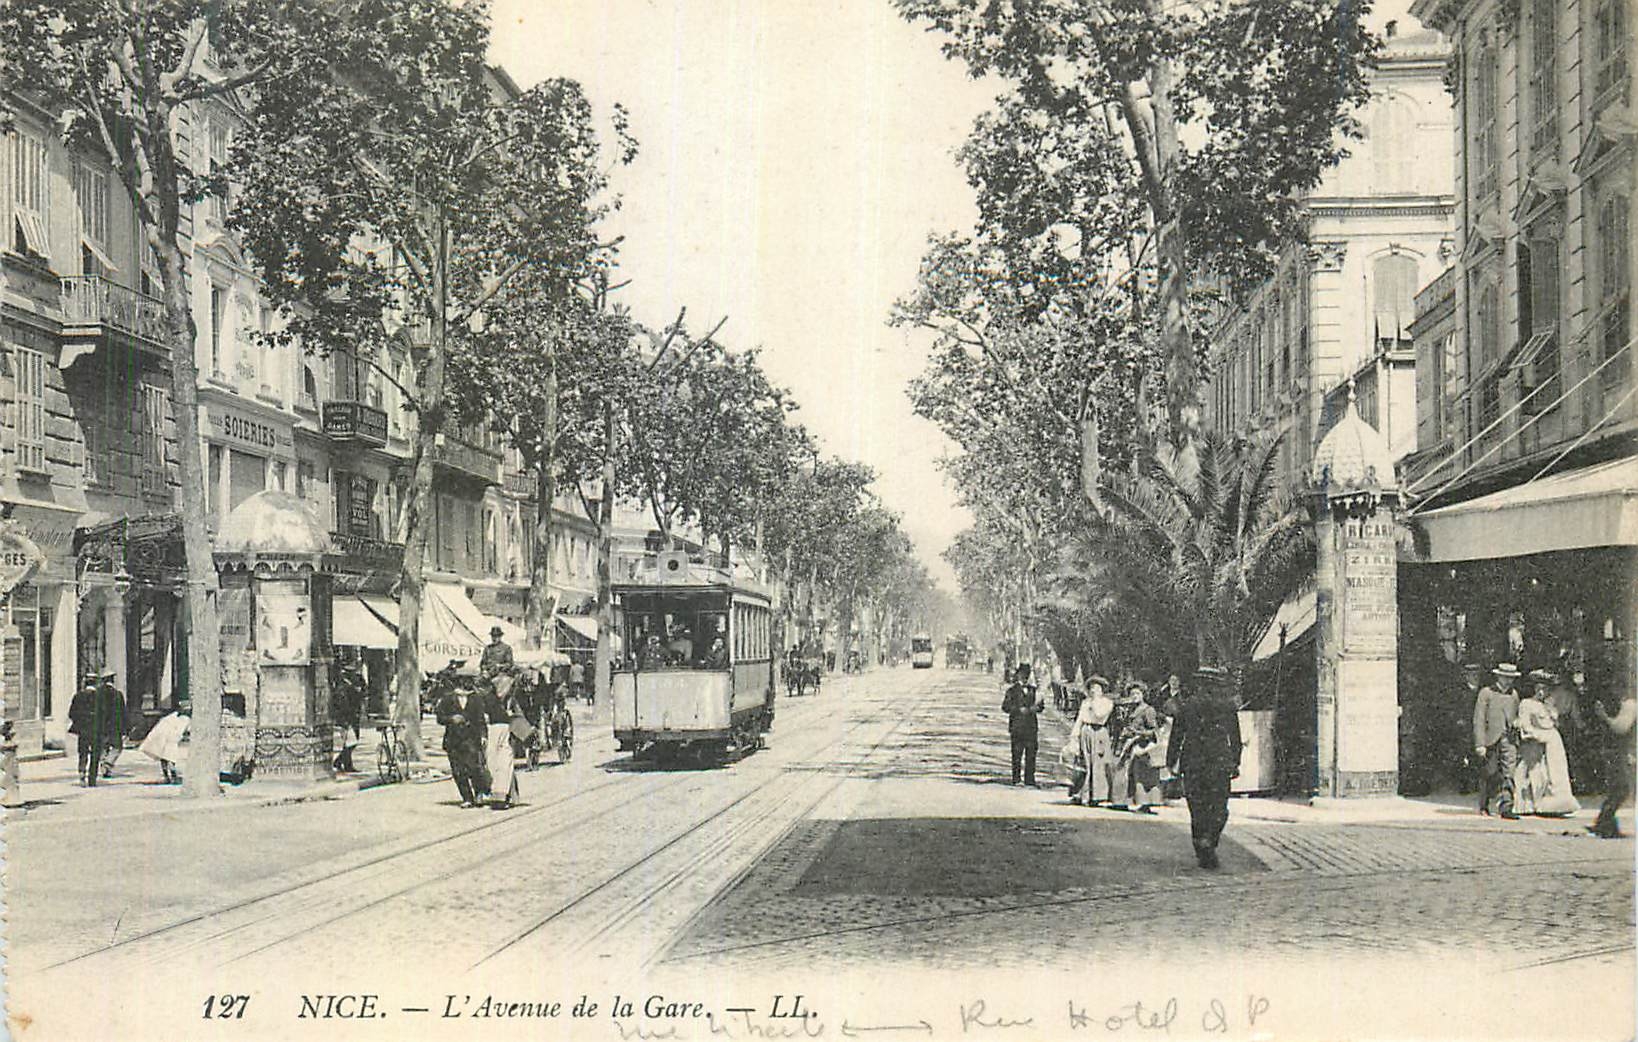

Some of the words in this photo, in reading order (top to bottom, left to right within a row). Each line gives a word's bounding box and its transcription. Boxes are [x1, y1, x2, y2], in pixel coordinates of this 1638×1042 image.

[224, 414, 276, 448] SOIERIES
[0, 553, 27, 566] GES
[424, 640, 482, 657] CORSETS
[1067, 997, 1178, 1032] Hotel
[1247, 994, 1271, 1027] P
